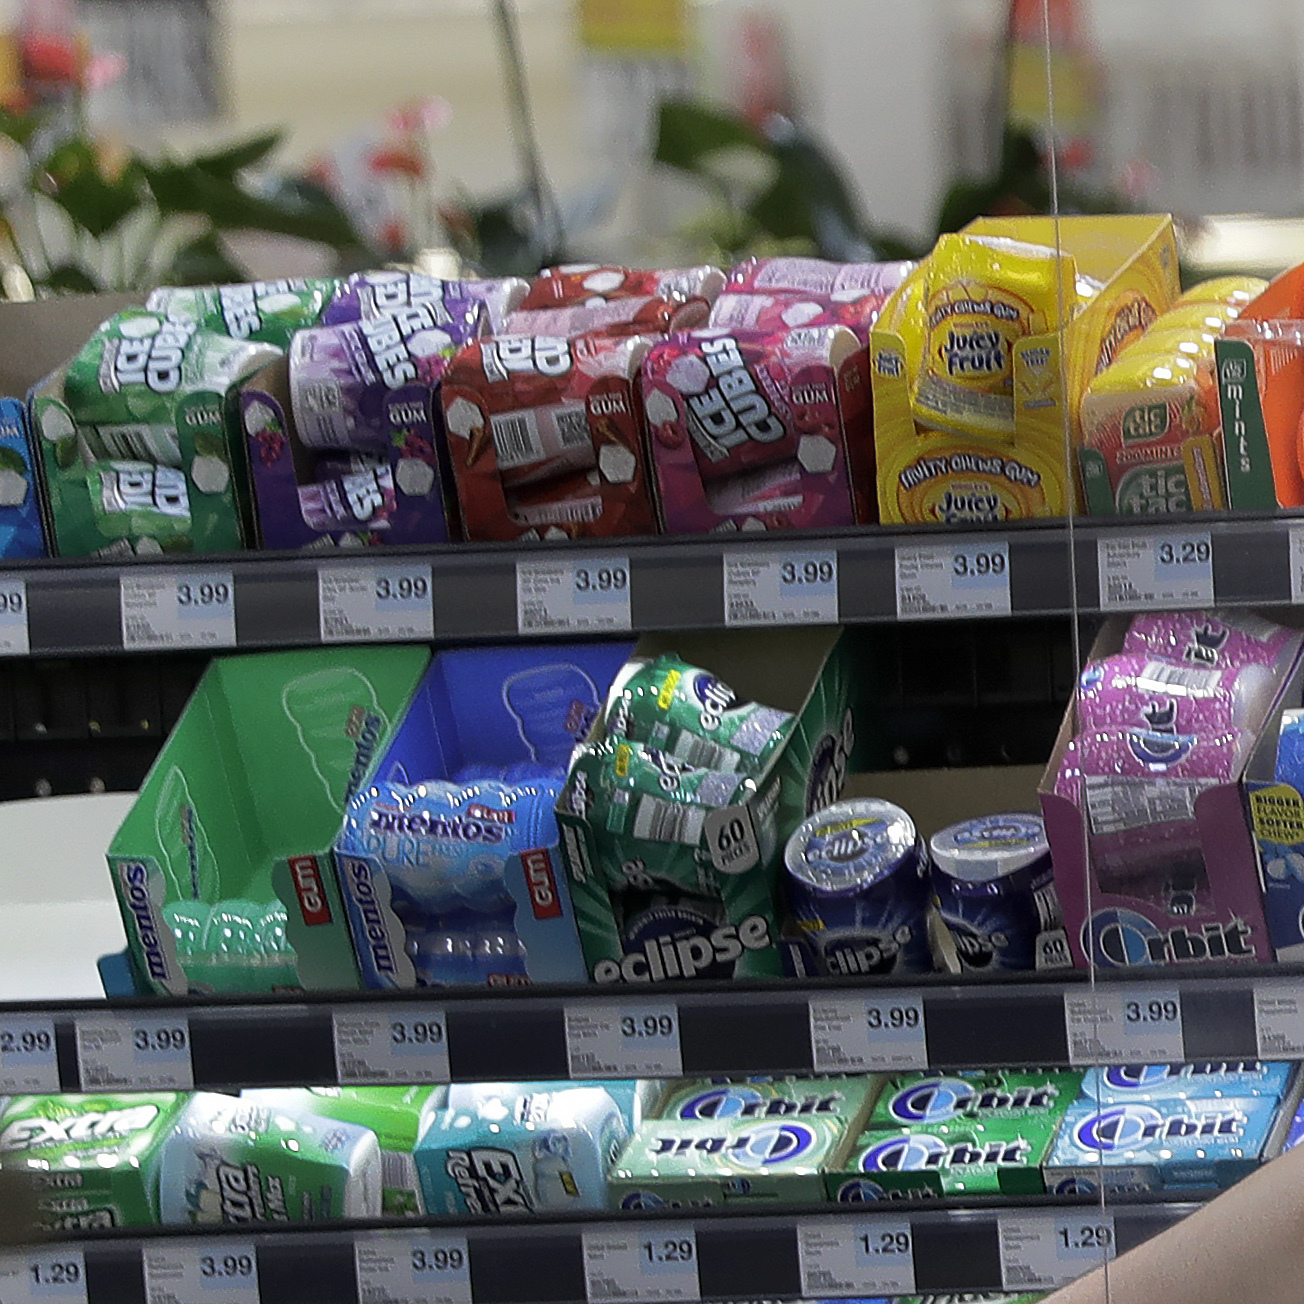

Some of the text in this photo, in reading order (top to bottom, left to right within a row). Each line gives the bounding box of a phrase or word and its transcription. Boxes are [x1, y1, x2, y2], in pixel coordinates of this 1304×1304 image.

[944, 330, 1000, 352] Juicy
[947, 350, 1006, 376] Fruit
[700, 337, 787, 443] CUBES
[688, 386, 750, 449] ICE
[953, 553, 1007, 576] 3.99
[1159, 541, 1211, 565] 3.29
[575, 568, 628, 591] 3.99
[781, 561, 834, 585] 3.99
[176, 584, 230, 606] 3.99
[375, 578, 429, 601] 3.99
[717, 817, 746, 849] 60
[126, 863, 170, 982] mentos
[352, 863, 396, 975] mentos
[593, 914, 772, 984] eclipse
[867, 1007, 920, 1031] 3.99
[1125, 1001, 1179, 1025] 3.99
[391, 1021, 444, 1045] 3.99
[620, 1014, 674, 1038] 3.99
[0, 1029, 52, 1053] 2.99
[133, 1027, 187, 1052] 3.99
[859, 1232, 910, 1256] 1.29
[1058, 1226, 1112, 1249] 1.29
[411, 1247, 465, 1272] 3.99
[643, 1239, 694, 1263] 1.29
[29, 1262, 80, 1285] 1.29
[200, 1254, 254, 1278] 3.99
